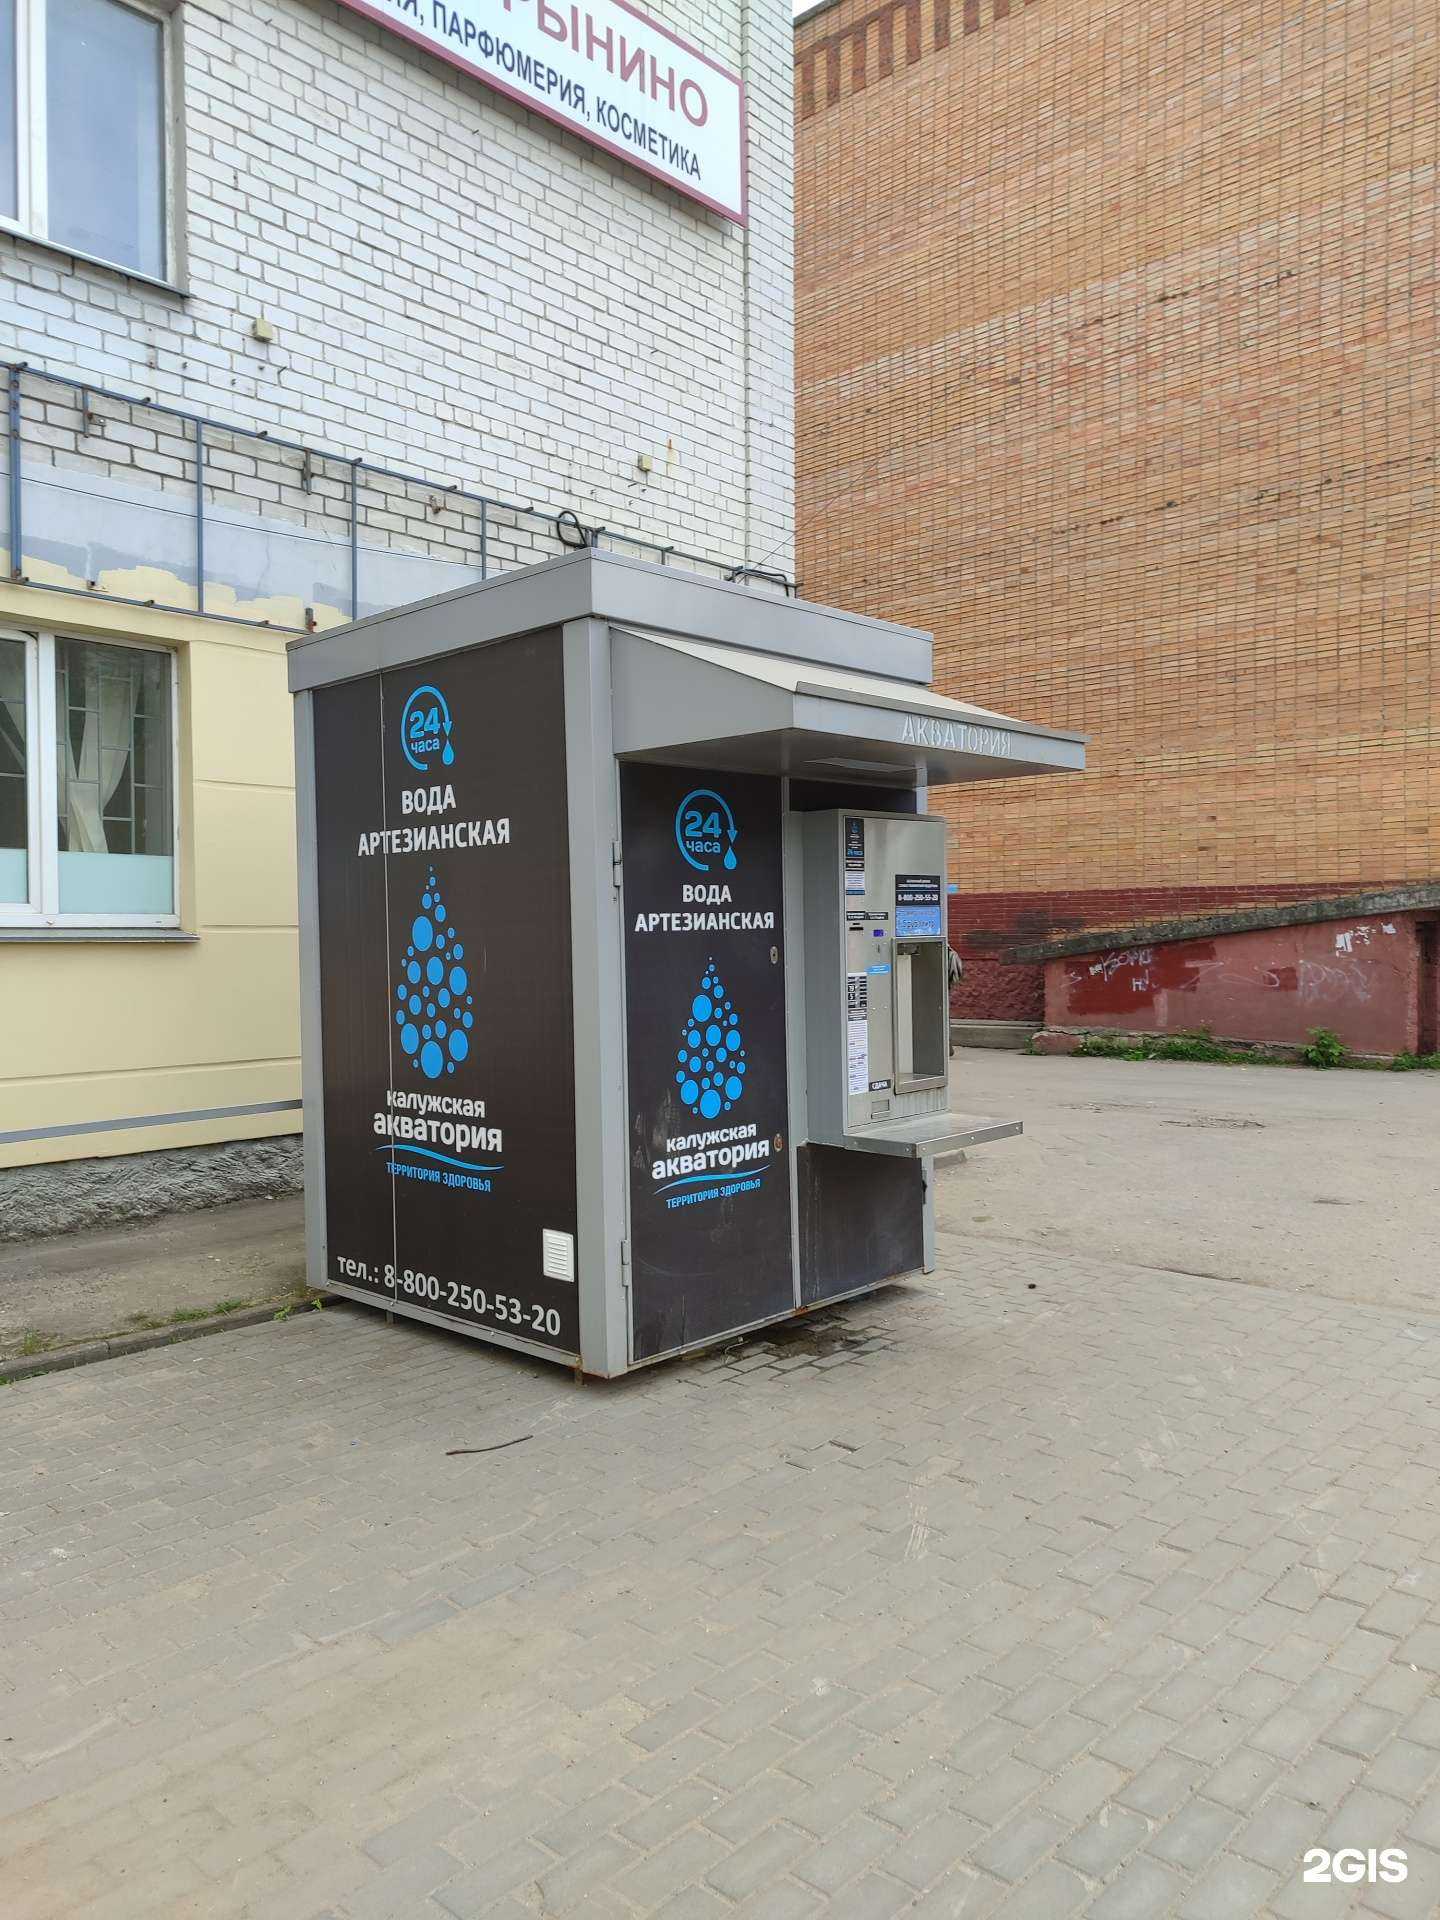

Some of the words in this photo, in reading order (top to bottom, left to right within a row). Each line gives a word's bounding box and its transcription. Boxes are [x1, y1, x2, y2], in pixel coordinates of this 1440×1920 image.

[503, 0, 708, 127] ЫНИНО
[432, 0, 591, 122] ПАРФЮМЕРИЯ,
[596, 96, 702, 180] КОСМЕТИКА
[409, 707, 441, 739] 24
[902, 714, 1011, 757] АКВАТОРИЯ
[411, 738, 440, 753] часа
[401, 784, 457, 816] ВОДА
[357, 817, 511, 857] АРТЕЗИАНСКАЯ
[684, 810, 722, 838] 24
[686, 840, 721, 853] часа
[682, 884, 732, 905] ВОДА
[634, 911, 775, 932] АРТЕЗИАНСКАЯ
[386, 1090, 486, 1118] калужская
[373, 1112, 503, 1153] акватория
[666, 1123, 757, 1153] калужская
[651, 1139, 770, 1180] акватория
[386, 1162, 441, 1183] ТЕРРИТОРИЯ
[442, 1172, 491, 1193] ЗДОРОВЬЯ
[666, 1188, 719, 1209] ТЕРРИТОРИЯ
[720, 1178, 761, 1198] ЗДОРОВЬЯ
[337, 1256, 379, 1284] тел.:
[384, 1264, 561, 1336] 8-800-250-53-20
